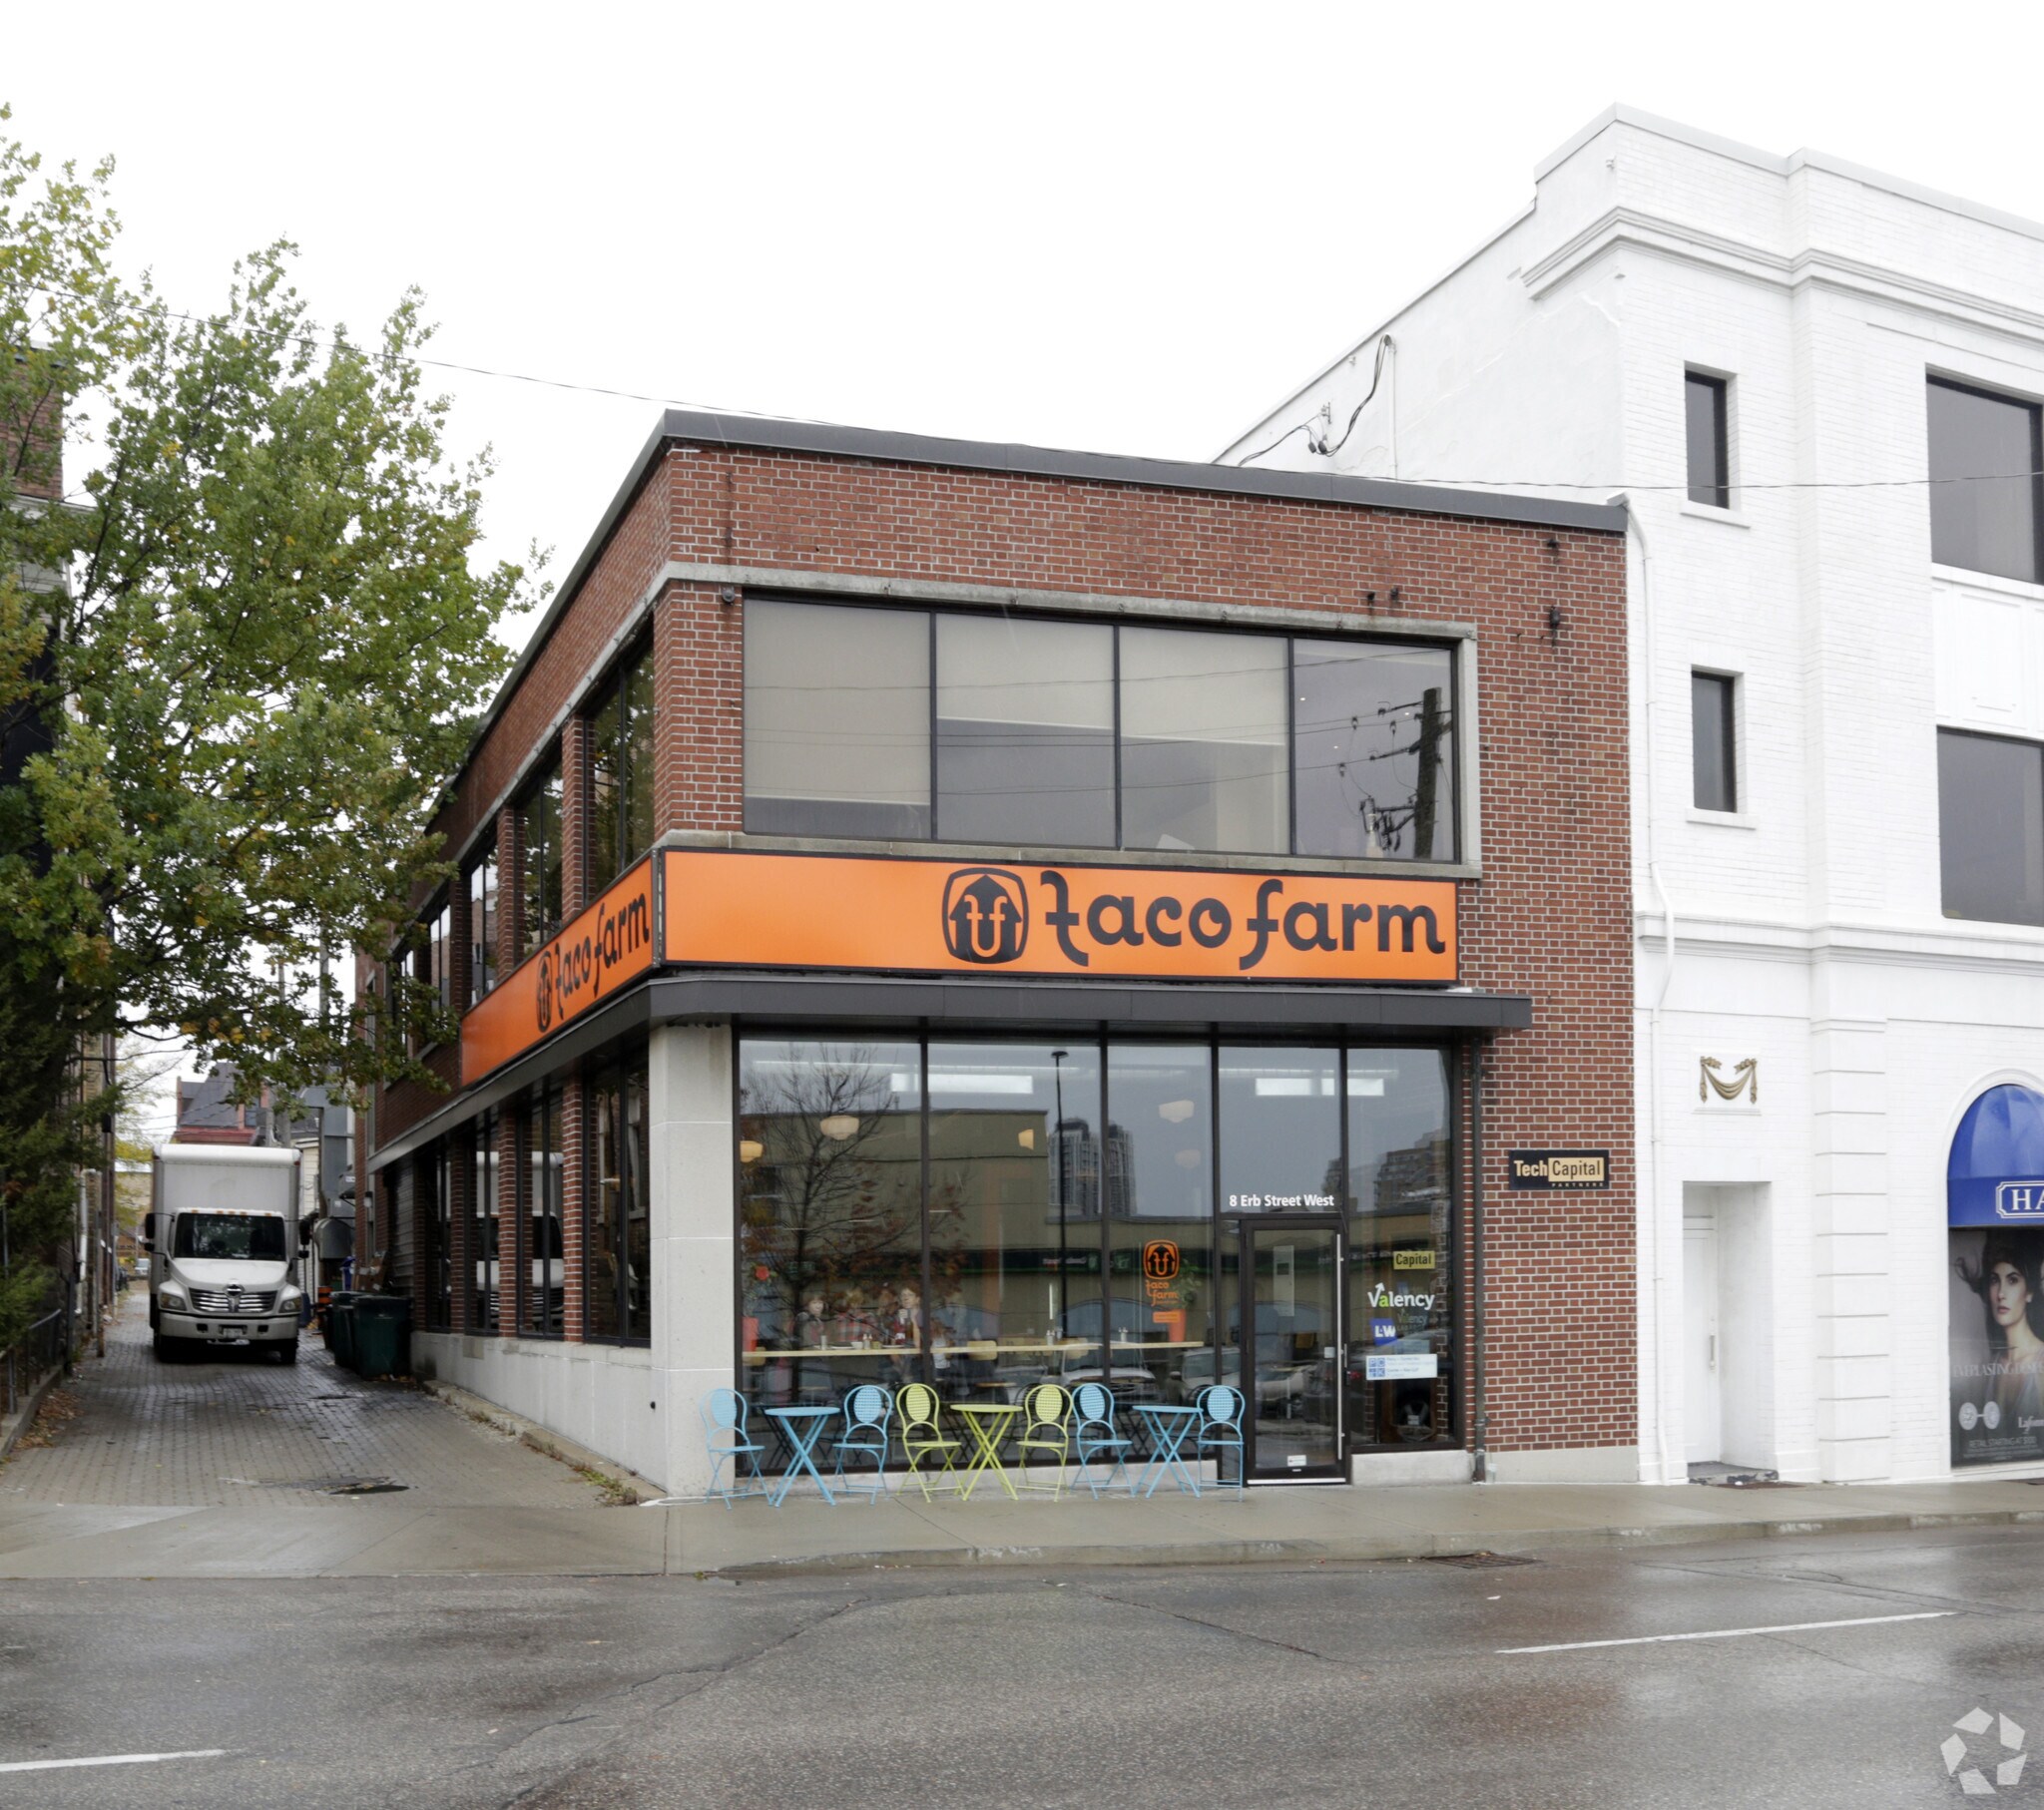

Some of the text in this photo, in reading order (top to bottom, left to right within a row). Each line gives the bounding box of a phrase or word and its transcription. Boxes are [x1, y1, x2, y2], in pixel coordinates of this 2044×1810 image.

[1040, 870, 1446, 971] taco farm
[555, 892, 650, 1020] taco farm
[1513, 1159, 1601, 1180] Tech Capital
[1229, 1193, 1334, 1207] 8 Erb Street West
[1395, 1253, 1432, 1267] Capital
[1367, 1283, 1435, 1310] Valency
